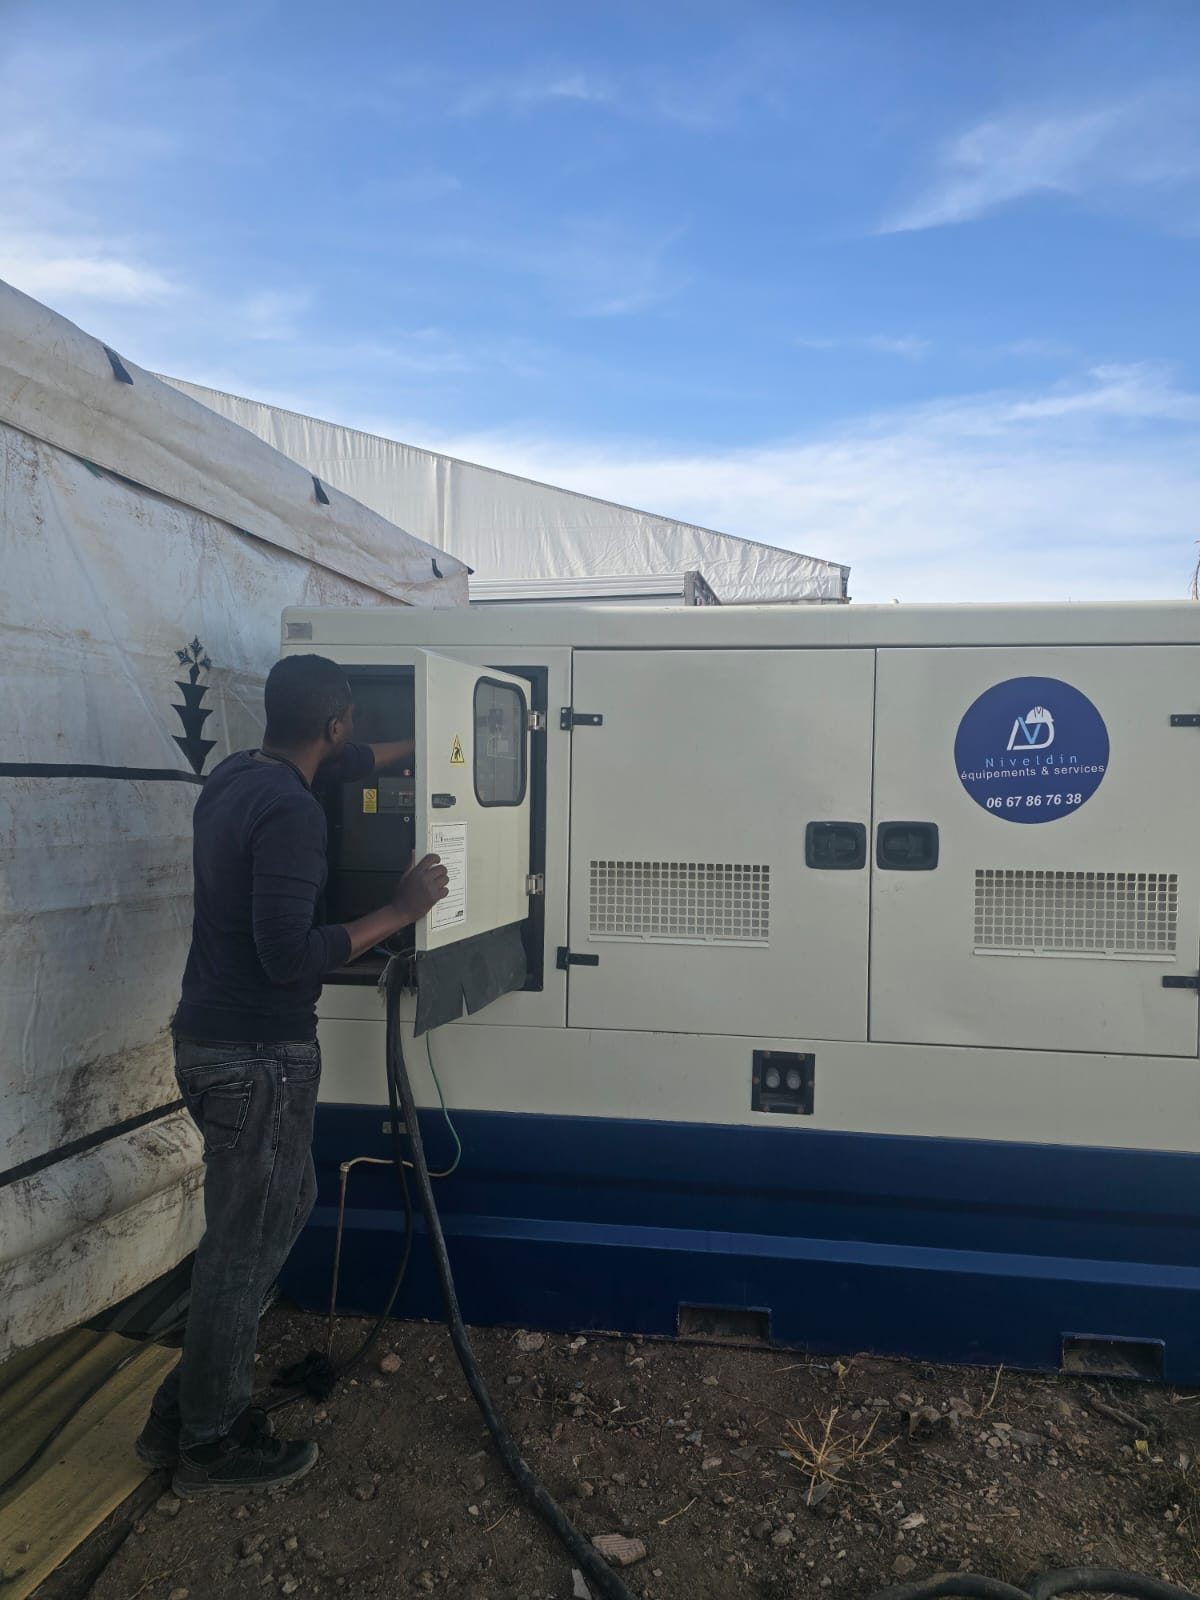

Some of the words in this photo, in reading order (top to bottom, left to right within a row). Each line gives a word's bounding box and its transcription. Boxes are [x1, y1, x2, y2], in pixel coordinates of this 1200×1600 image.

[985, 754, 1078, 768] Niveldin
[960, 767, 1036, 781] équipements
[1041, 766, 1049, 776] &
[1054, 764, 1105, 774] services
[986, 797, 1002, 808] 06
[1006, 796, 1022, 807] 67
[1025, 795, 1042, 806] 86
[1046, 794, 1062, 805] 76
[1065, 793, 1082, 804] 38
